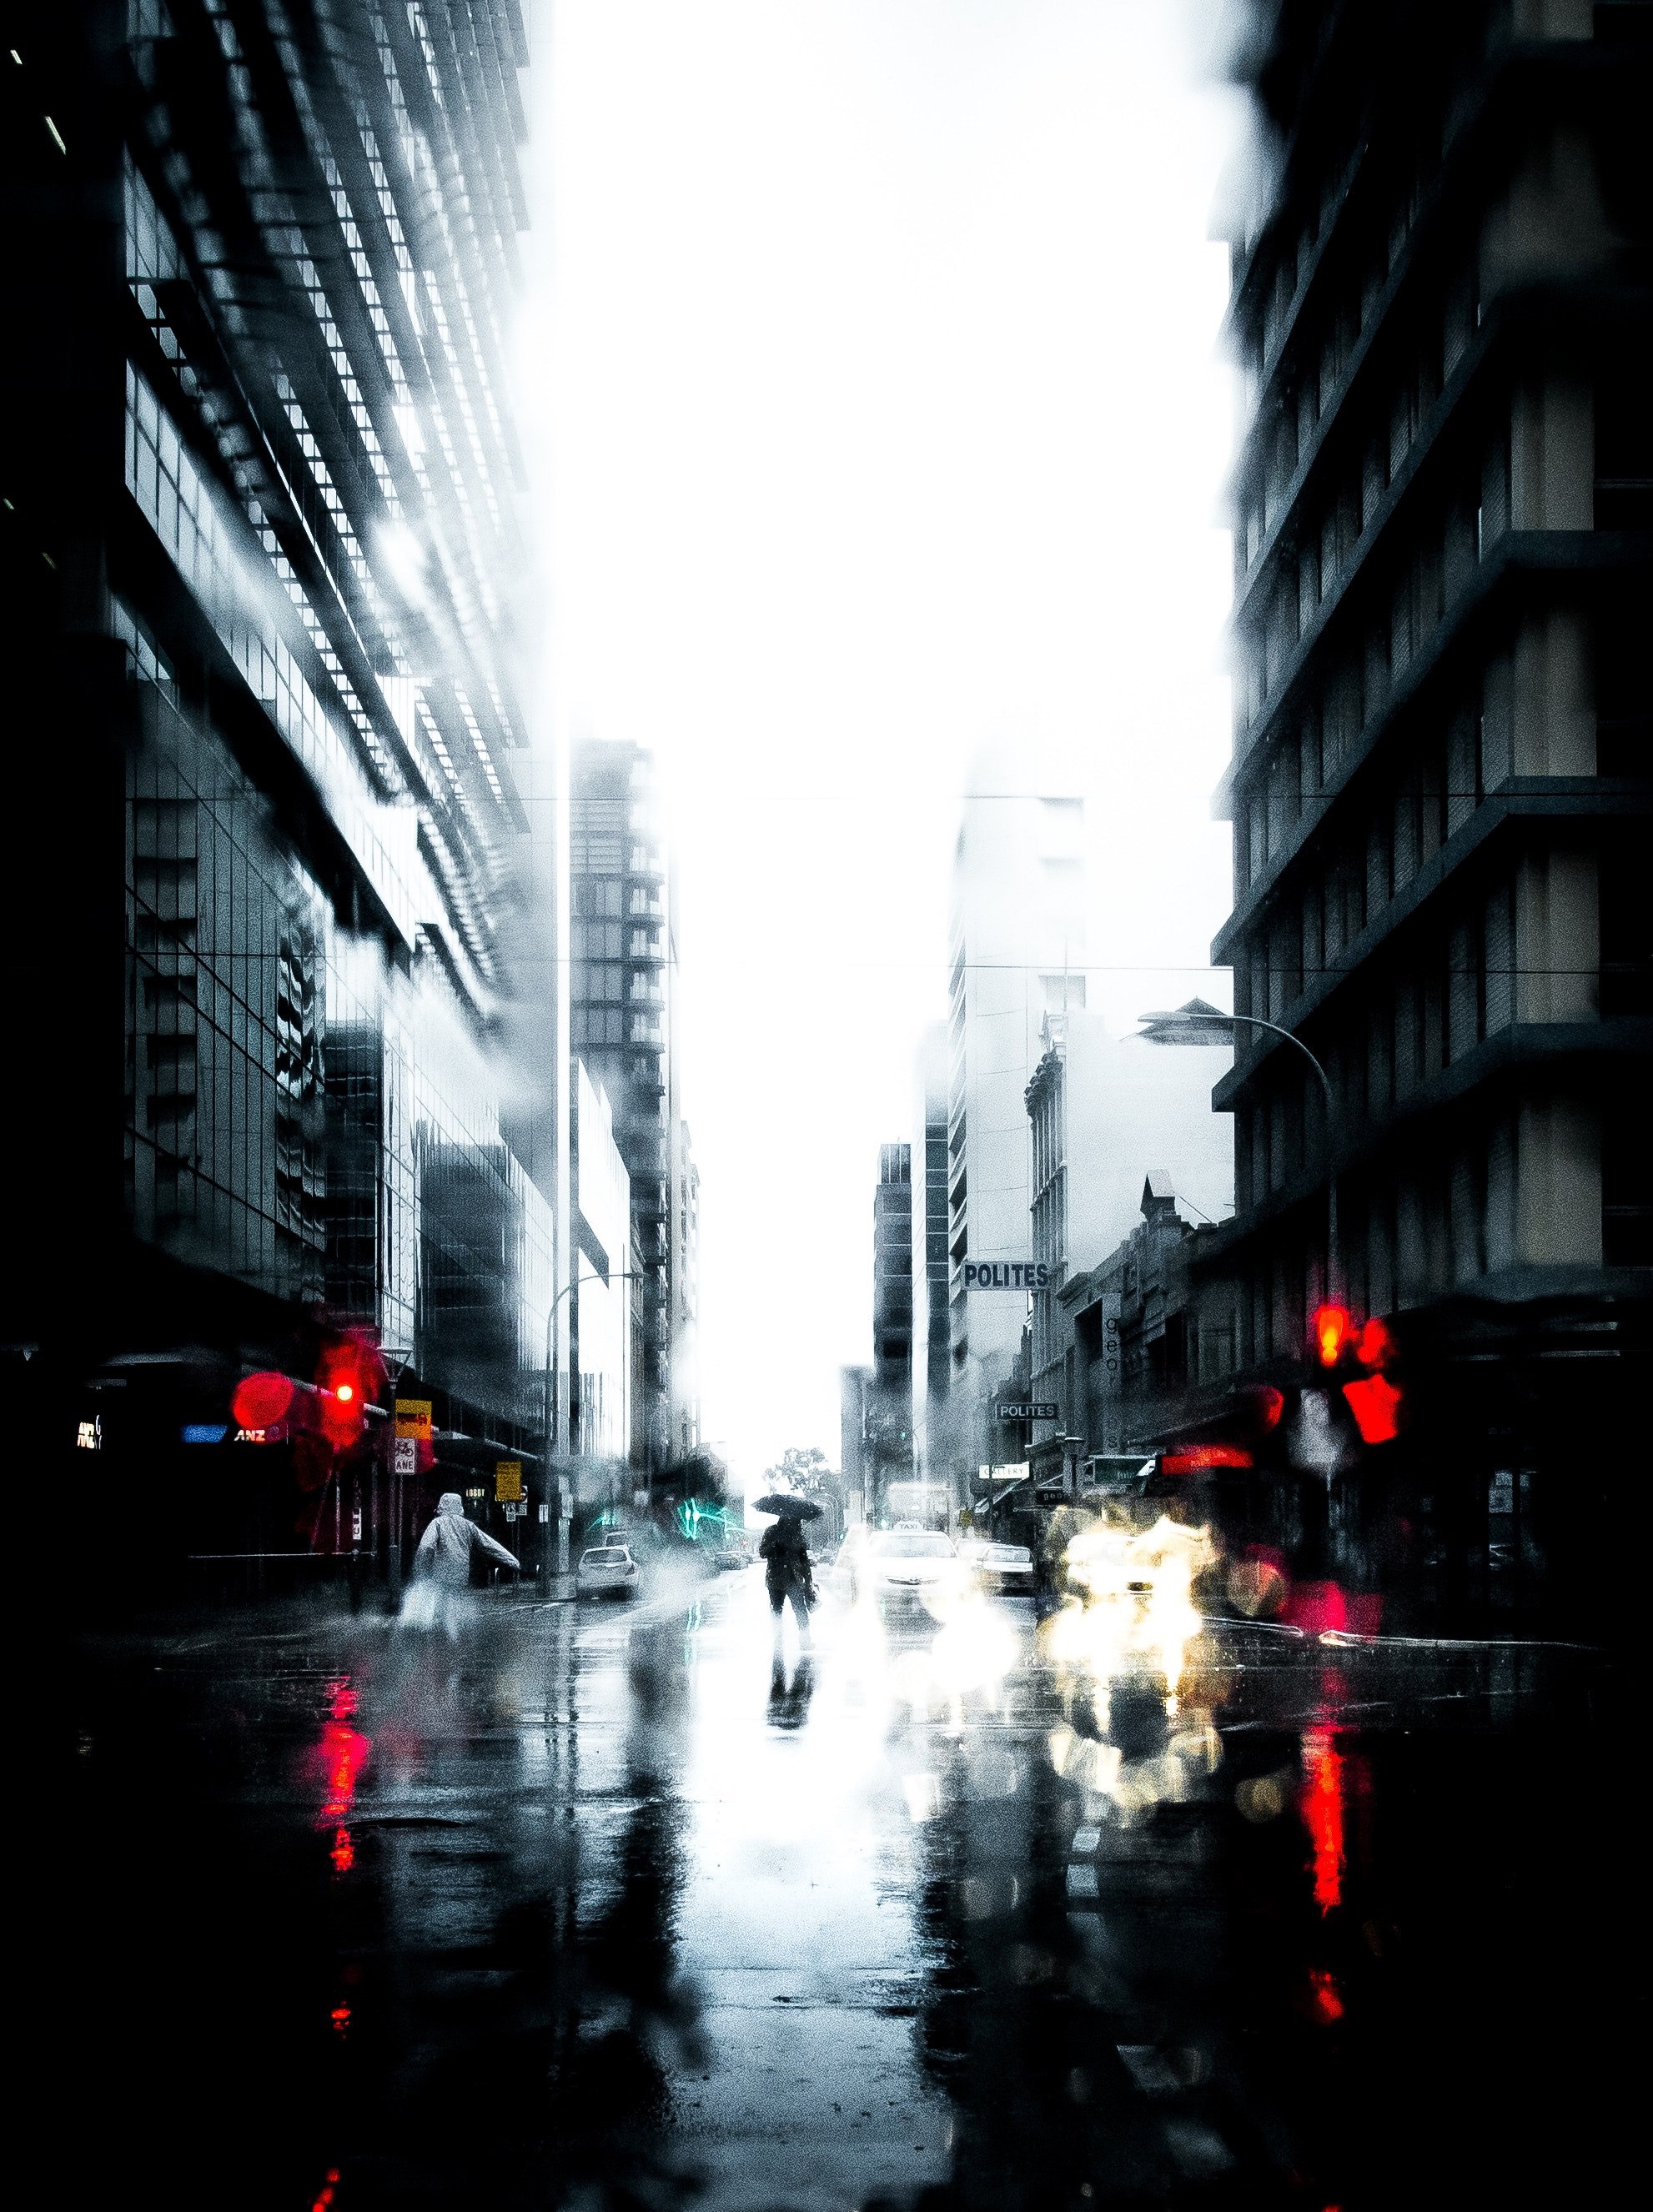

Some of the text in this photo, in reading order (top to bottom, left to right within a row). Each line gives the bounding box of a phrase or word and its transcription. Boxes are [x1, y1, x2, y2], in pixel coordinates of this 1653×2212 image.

[964, 1263, 1048, 1287] POLITES
[1000, 1406, 1054, 1417] POLITES
[234, 1429, 266, 1442] ANZ
[396, 1461, 414, 1470] ANE
